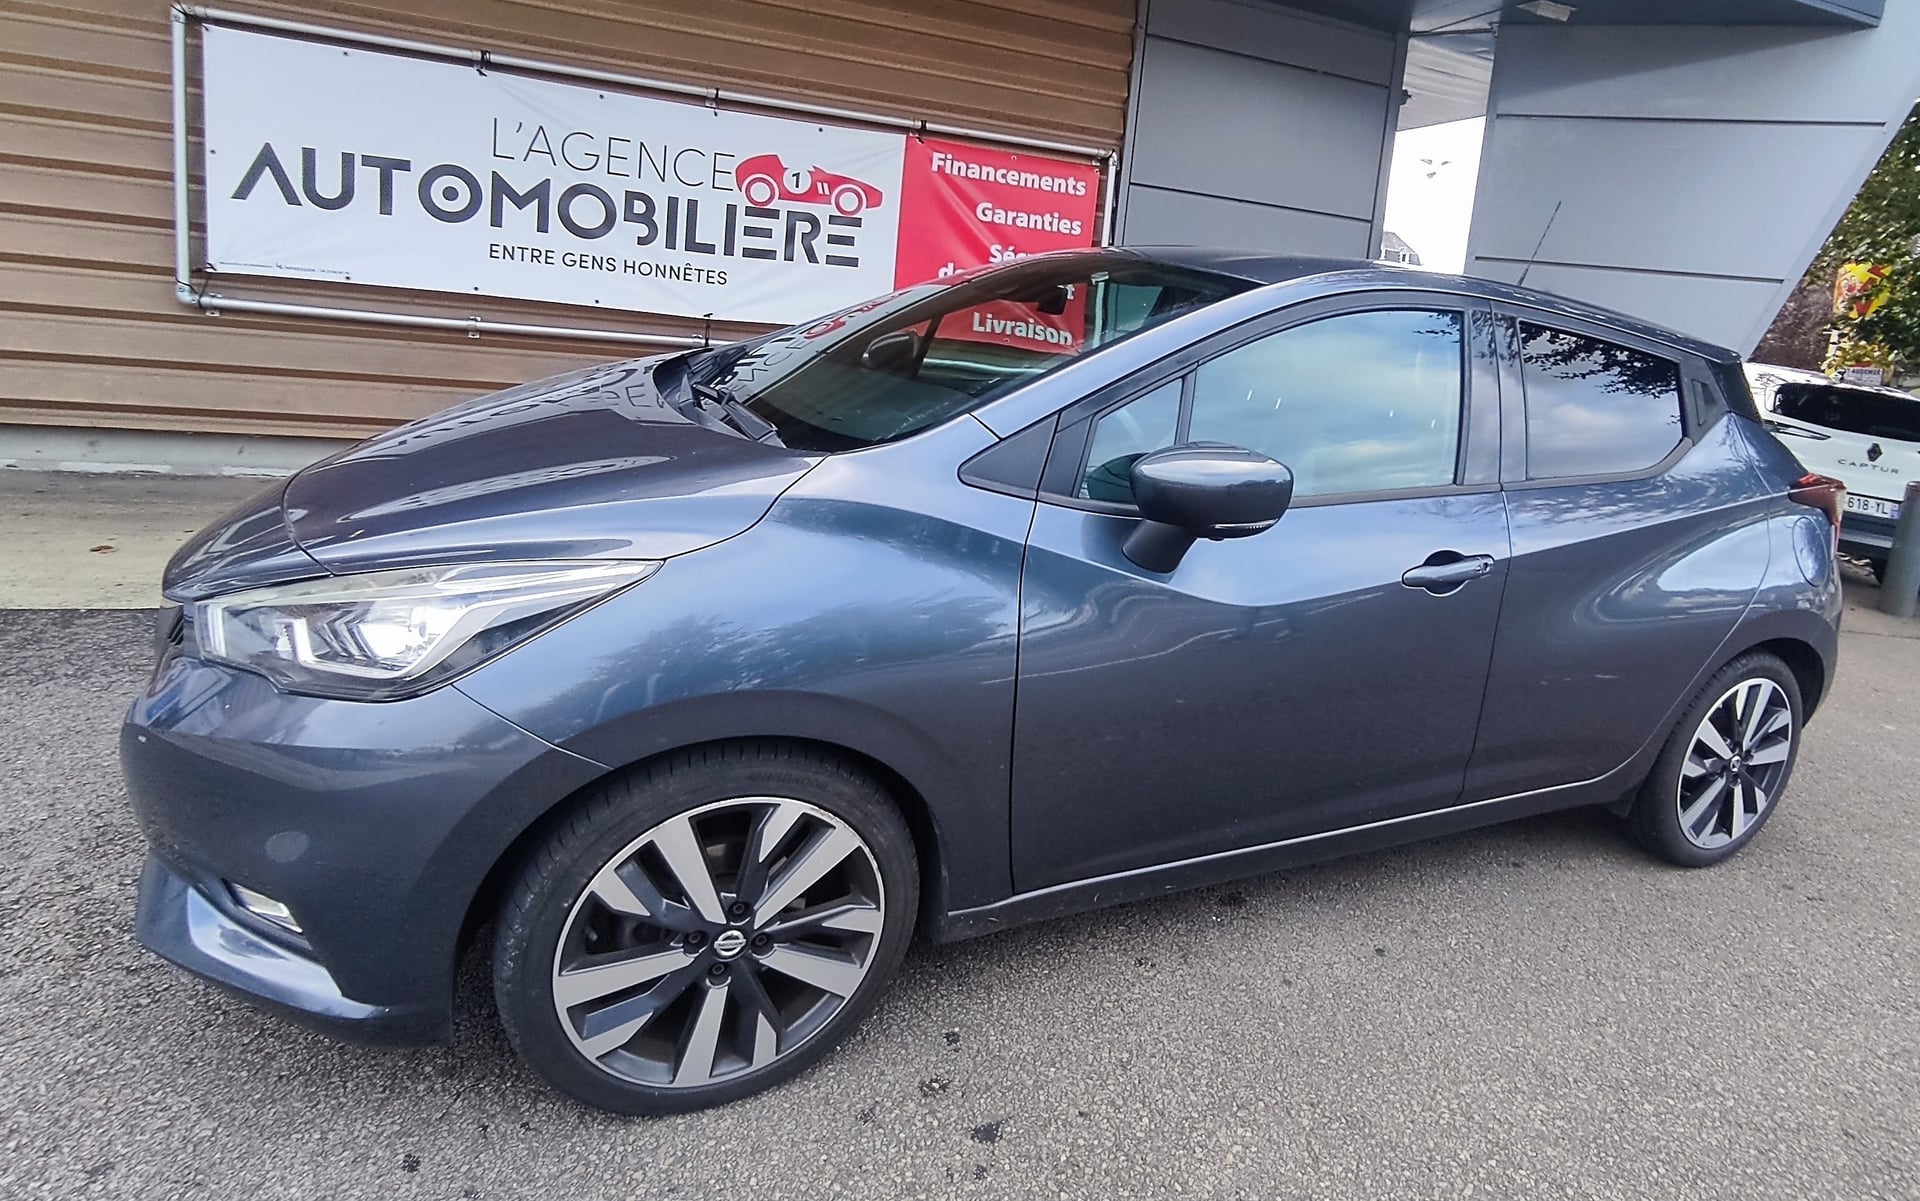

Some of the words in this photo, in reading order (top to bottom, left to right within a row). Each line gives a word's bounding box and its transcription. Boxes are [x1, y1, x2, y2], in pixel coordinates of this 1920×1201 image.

[492, 117, 736, 192] L'AGENCE
[931, 152, 1087, 196] Financements
[975, 202, 1082, 235] Garanties
[489, 244, 555, 265] ENTRE
[562, 251, 617, 272] GENS
[623, 259, 728, 285] HONNÊTES
[972, 312, 1073, 346] Livraison
[1837, 459, 1899, 474] CAPTUR
